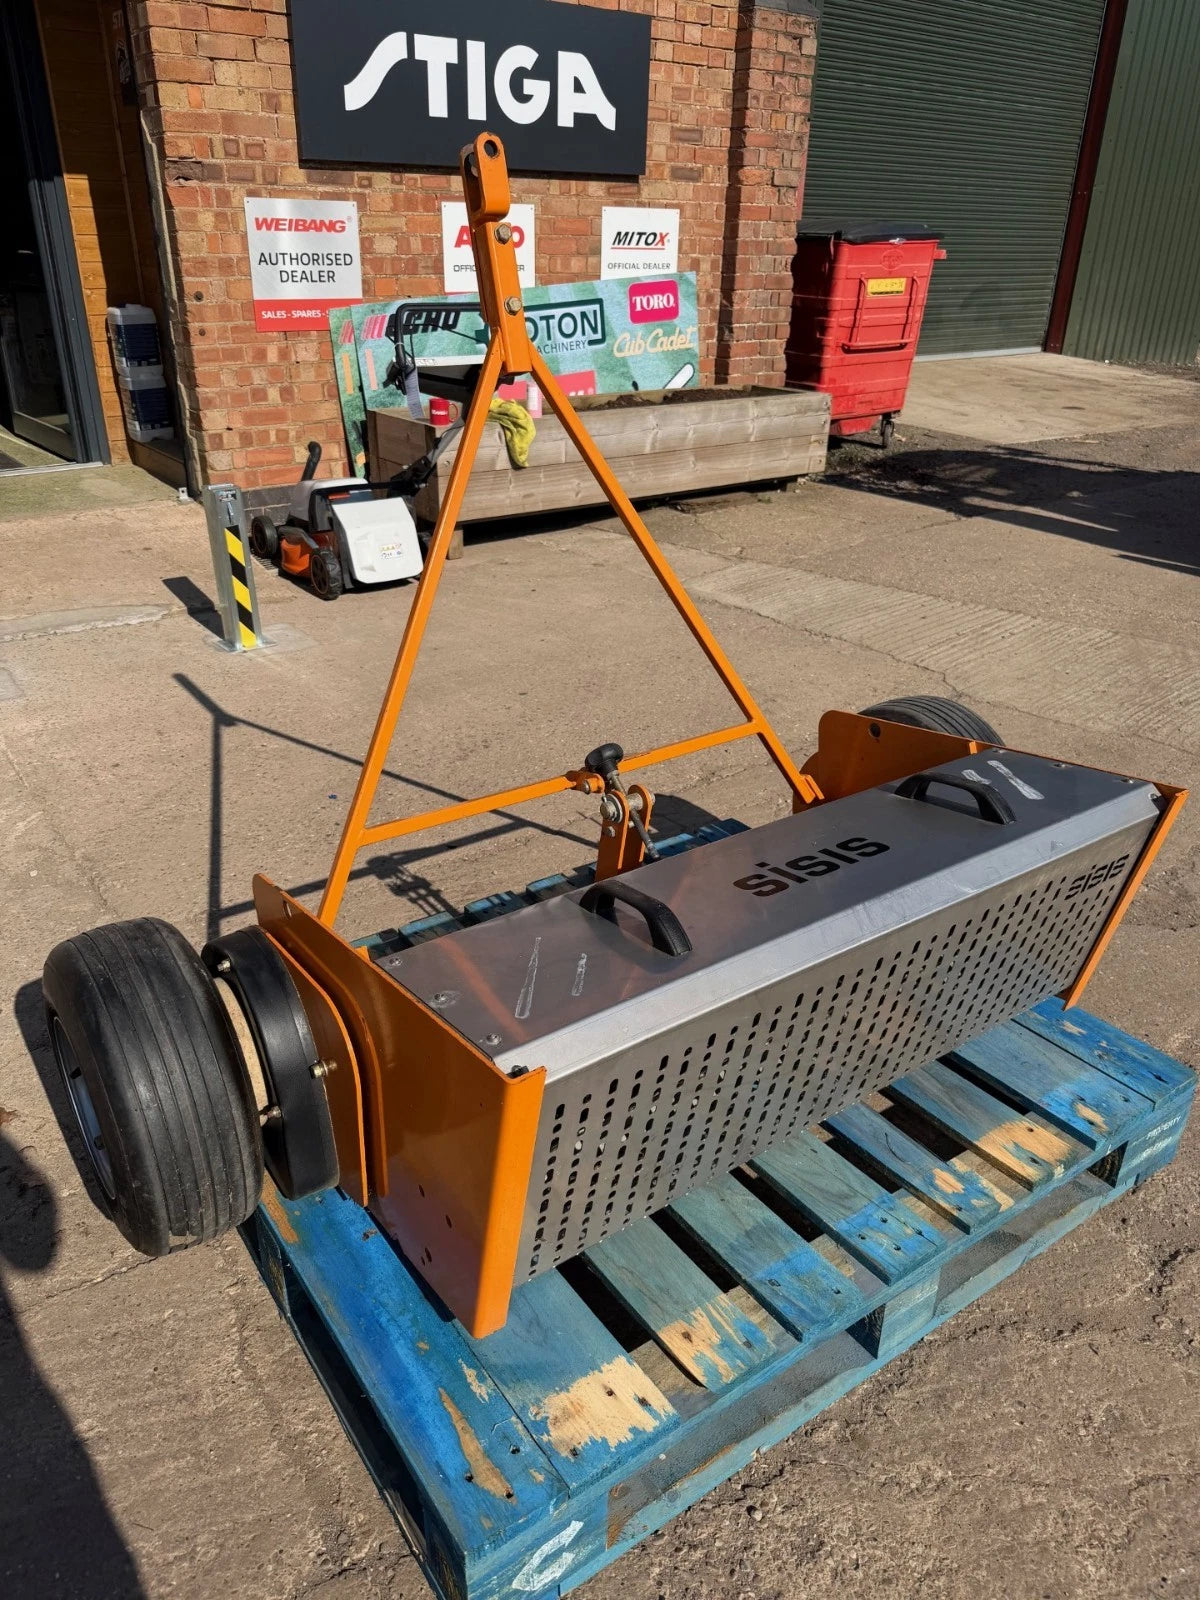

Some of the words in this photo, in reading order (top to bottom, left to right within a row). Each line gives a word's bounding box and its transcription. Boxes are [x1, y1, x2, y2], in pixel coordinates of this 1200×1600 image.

[344, 31, 617, 131] STIGA
[254, 217, 347, 233] WEIBANG
[612, 231, 669, 247] MITOX
[258, 252, 353, 266] AUTHORISED
[607, 262, 641, 270] OFFICIAL
[643, 262, 671, 270] DEALER
[279, 270, 336, 283] DEALER
[632, 293, 674, 312] TORO
[261, 310, 287, 318] SALES
[291, 310, 321, 318] SPARES
[524, 309, 599, 343] OTON
[537, 339, 587, 354] ACHINERY
[613, 332, 645, 358] Cub
[646, 326, 697, 352] Cadet
